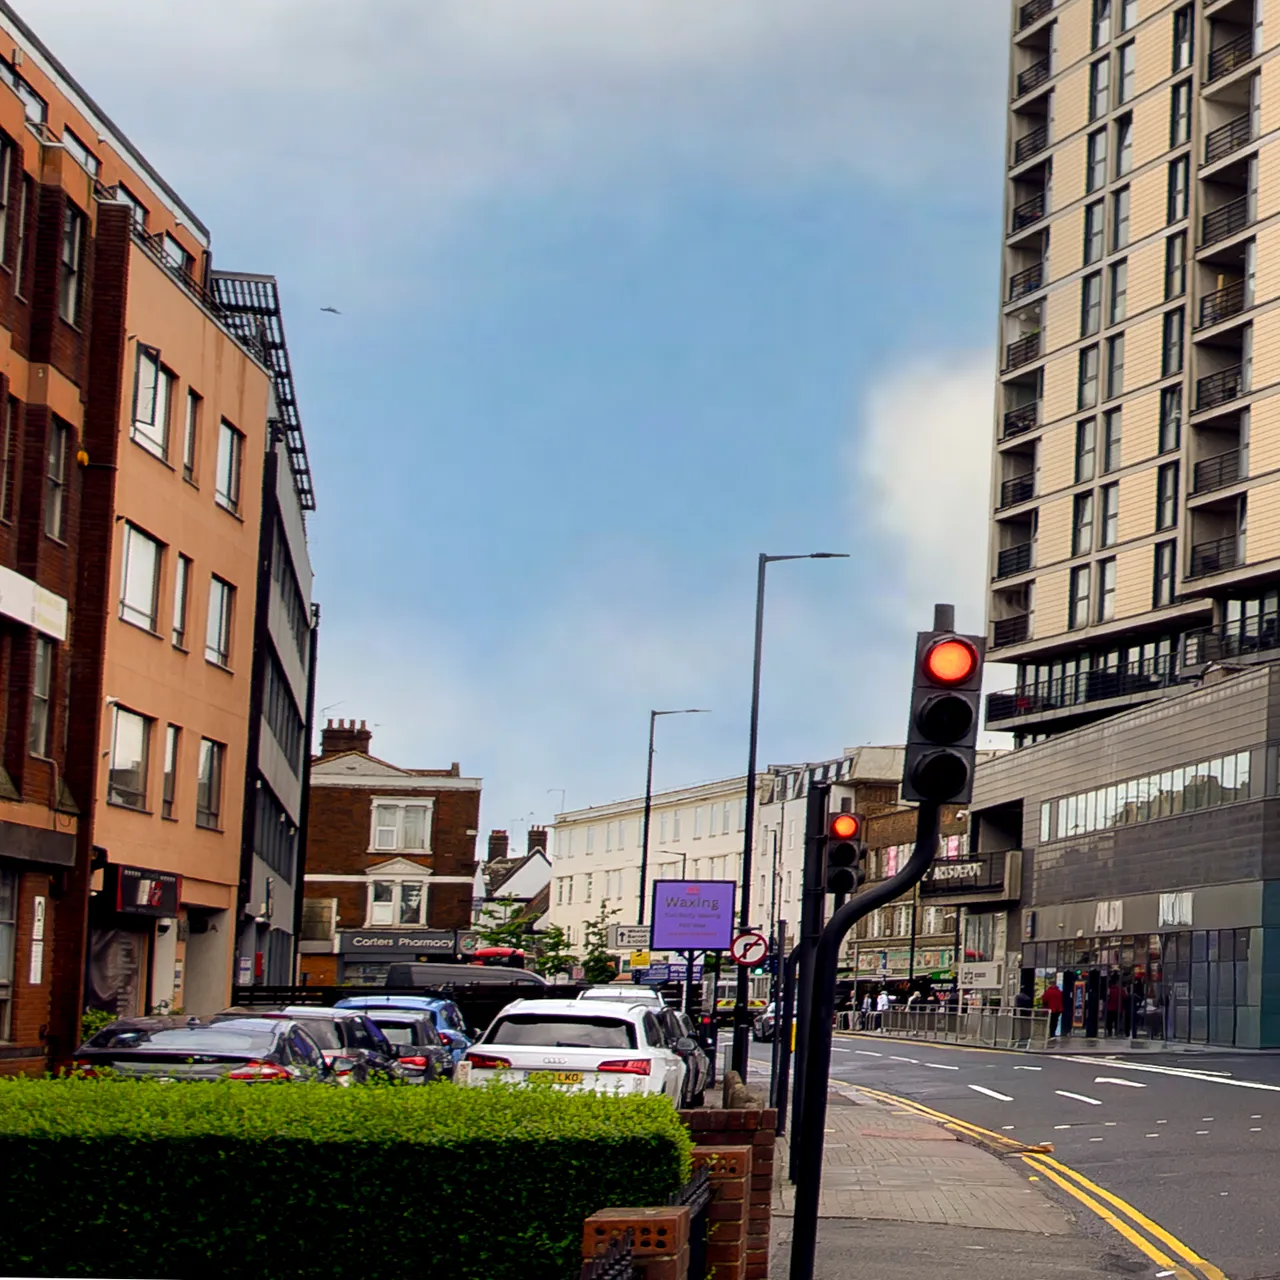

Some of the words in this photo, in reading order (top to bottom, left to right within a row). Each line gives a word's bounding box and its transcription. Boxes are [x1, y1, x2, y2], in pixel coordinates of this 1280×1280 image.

[665, 896, 719, 911] Waxing
[353, 937, 394, 947] Carters
[398, 938, 455, 949] Pharmacy
